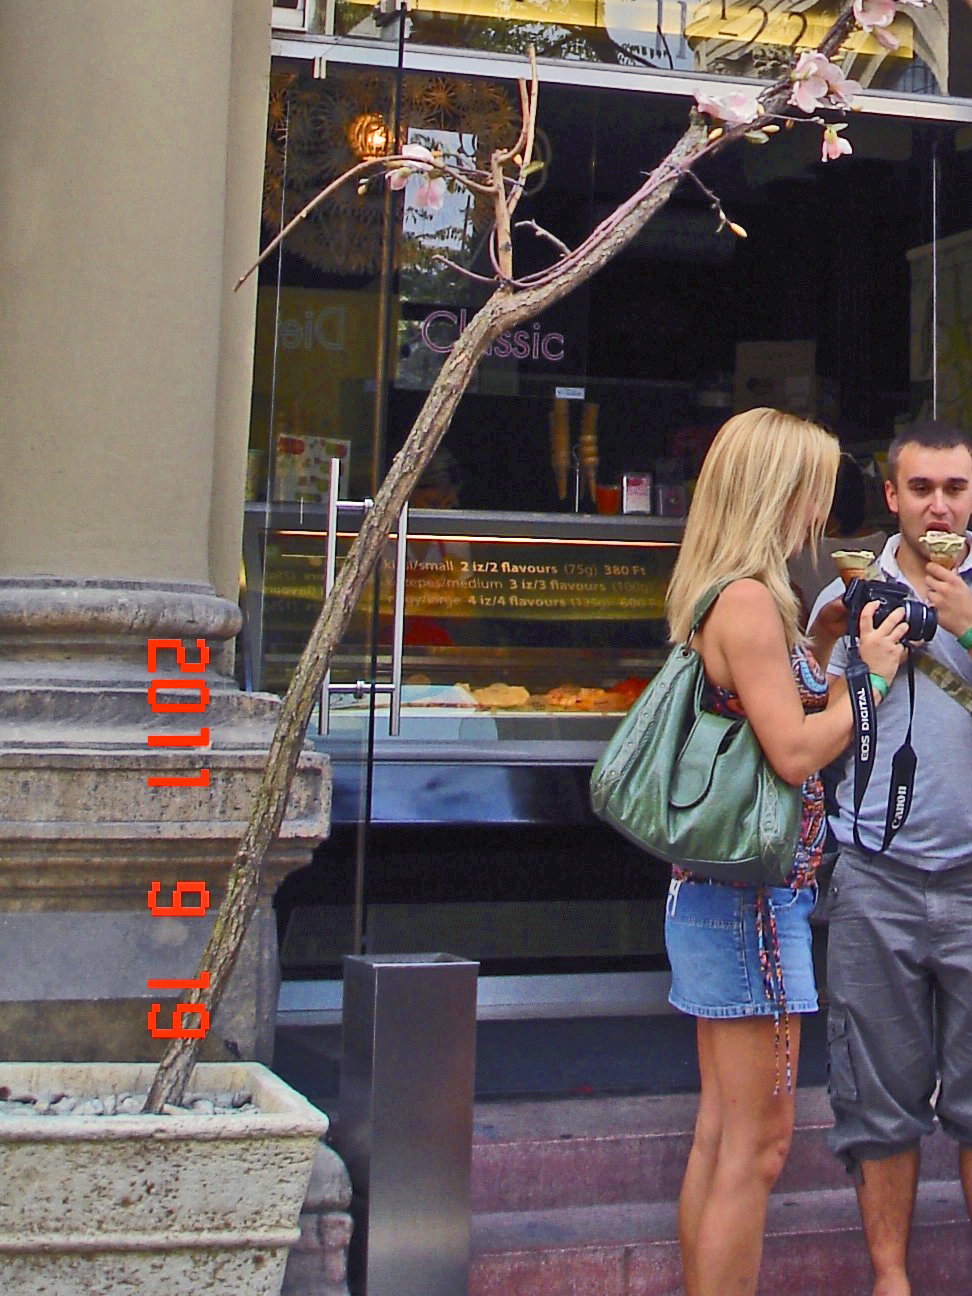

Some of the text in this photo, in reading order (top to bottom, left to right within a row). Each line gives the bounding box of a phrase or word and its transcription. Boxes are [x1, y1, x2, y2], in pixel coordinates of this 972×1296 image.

[421, 308, 564, 361] Clssic
[461, 562, 469, 572] 2
[473, 562, 498, 573] iz/2
[501, 562, 558, 574] flavours
[509, 579, 518, 590] 3
[522, 579, 547, 591] iz/3
[550, 579, 606, 592] flavours
[467, 595, 477, 606] 4
[480, 595, 506, 607] iz/4
[509, 595, 566, 608] flavours
[858, 687, 870, 761] EOS DIGITAL
[891, 785, 907, 830] Canon
